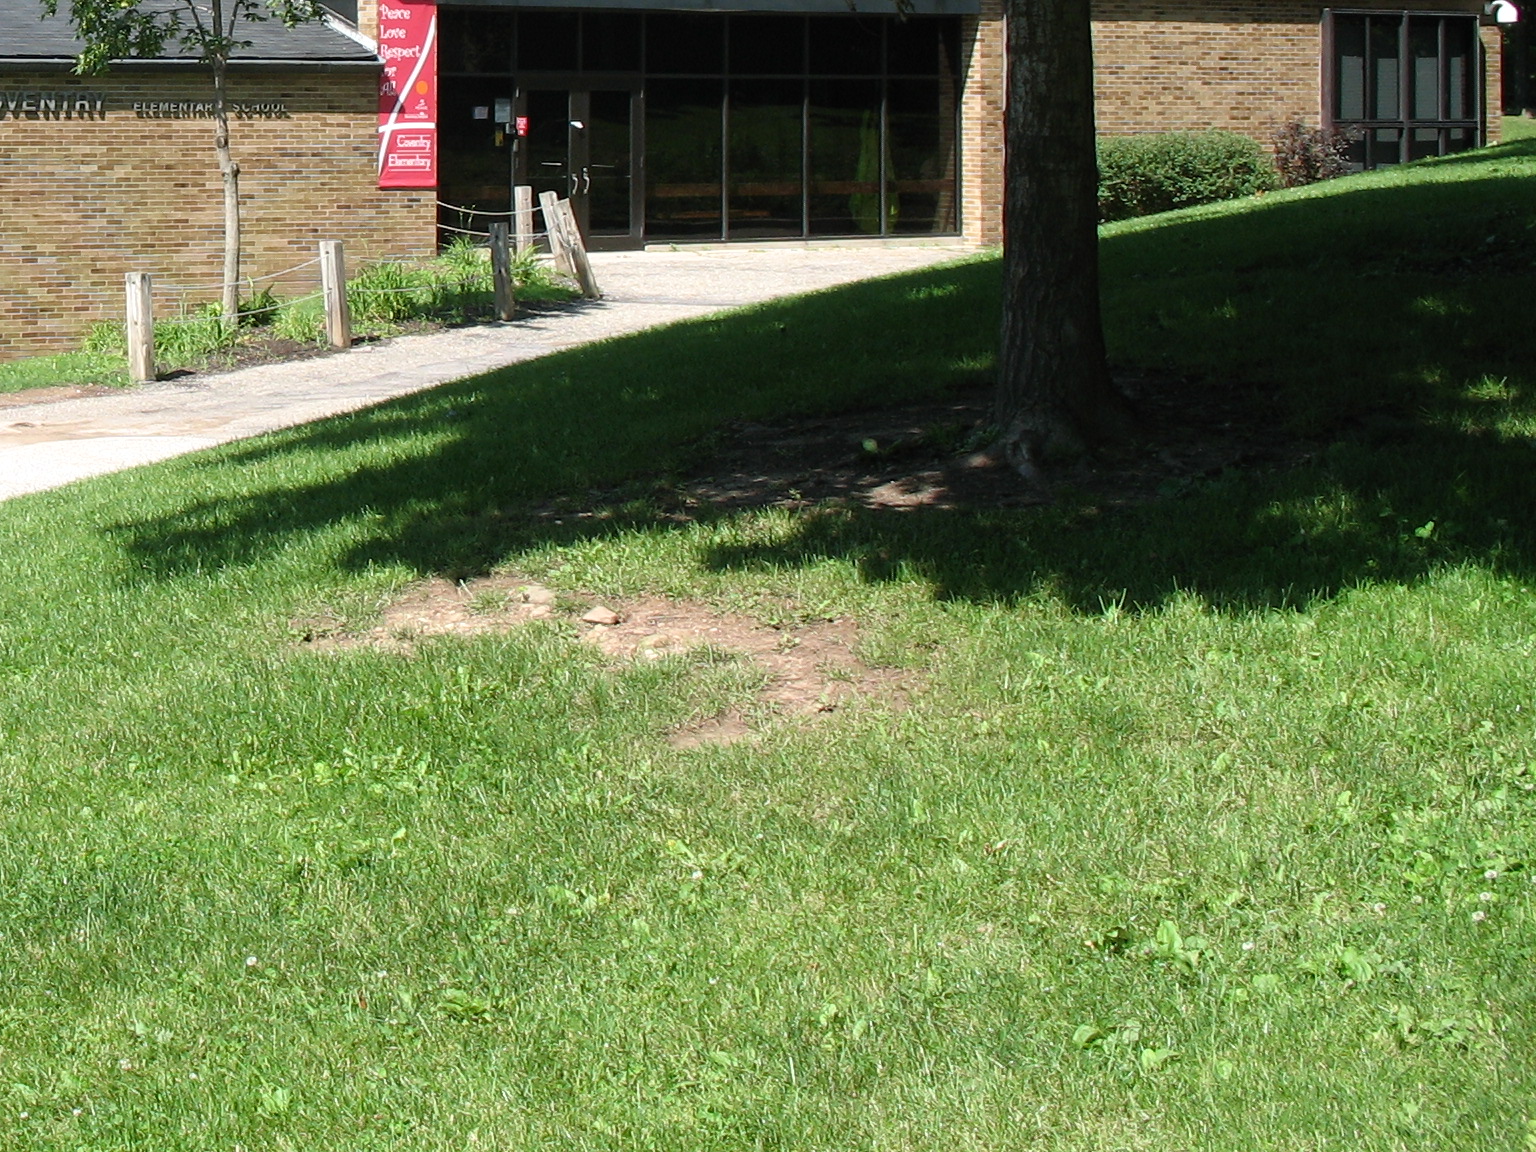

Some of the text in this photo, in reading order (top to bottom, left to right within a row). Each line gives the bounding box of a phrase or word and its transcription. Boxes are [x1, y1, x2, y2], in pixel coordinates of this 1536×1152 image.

[379, 3, 411, 20] Peace
[380, 24, 407, 39] Love
[380, 43, 421, 61] Respect
[133, 101, 215, 112] ELEMENTAR
[232, 101, 288, 112] SCHOOL
[397, 134, 431, 151] Coventry
[388, 153, 431, 170] Elementary
